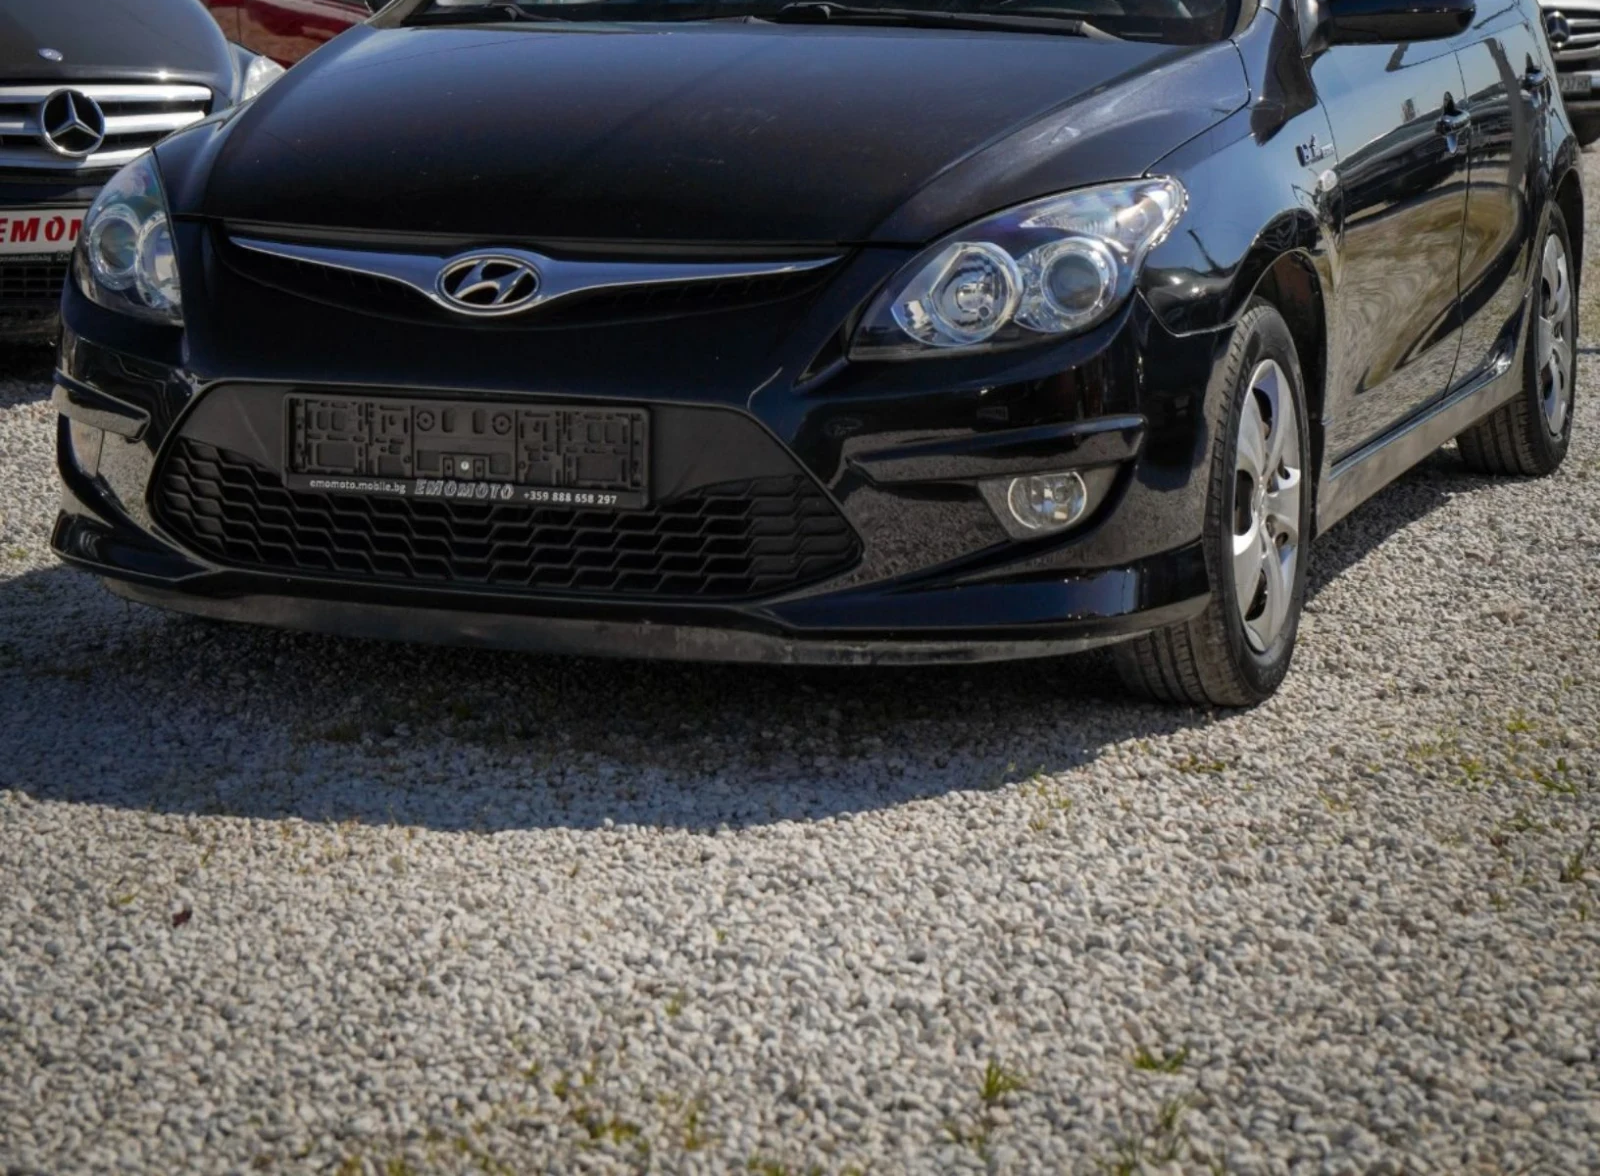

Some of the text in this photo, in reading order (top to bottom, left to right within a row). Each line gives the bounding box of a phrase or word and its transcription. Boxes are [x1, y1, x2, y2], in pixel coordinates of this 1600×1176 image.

[309, 479, 406, 495] emomoto.mobile.bg
[414, 479, 514, 500] EMOMOTO
[523, 490, 549, 501] +359
[552, 491, 571, 502] 888
[597, 494, 617, 505] 297
